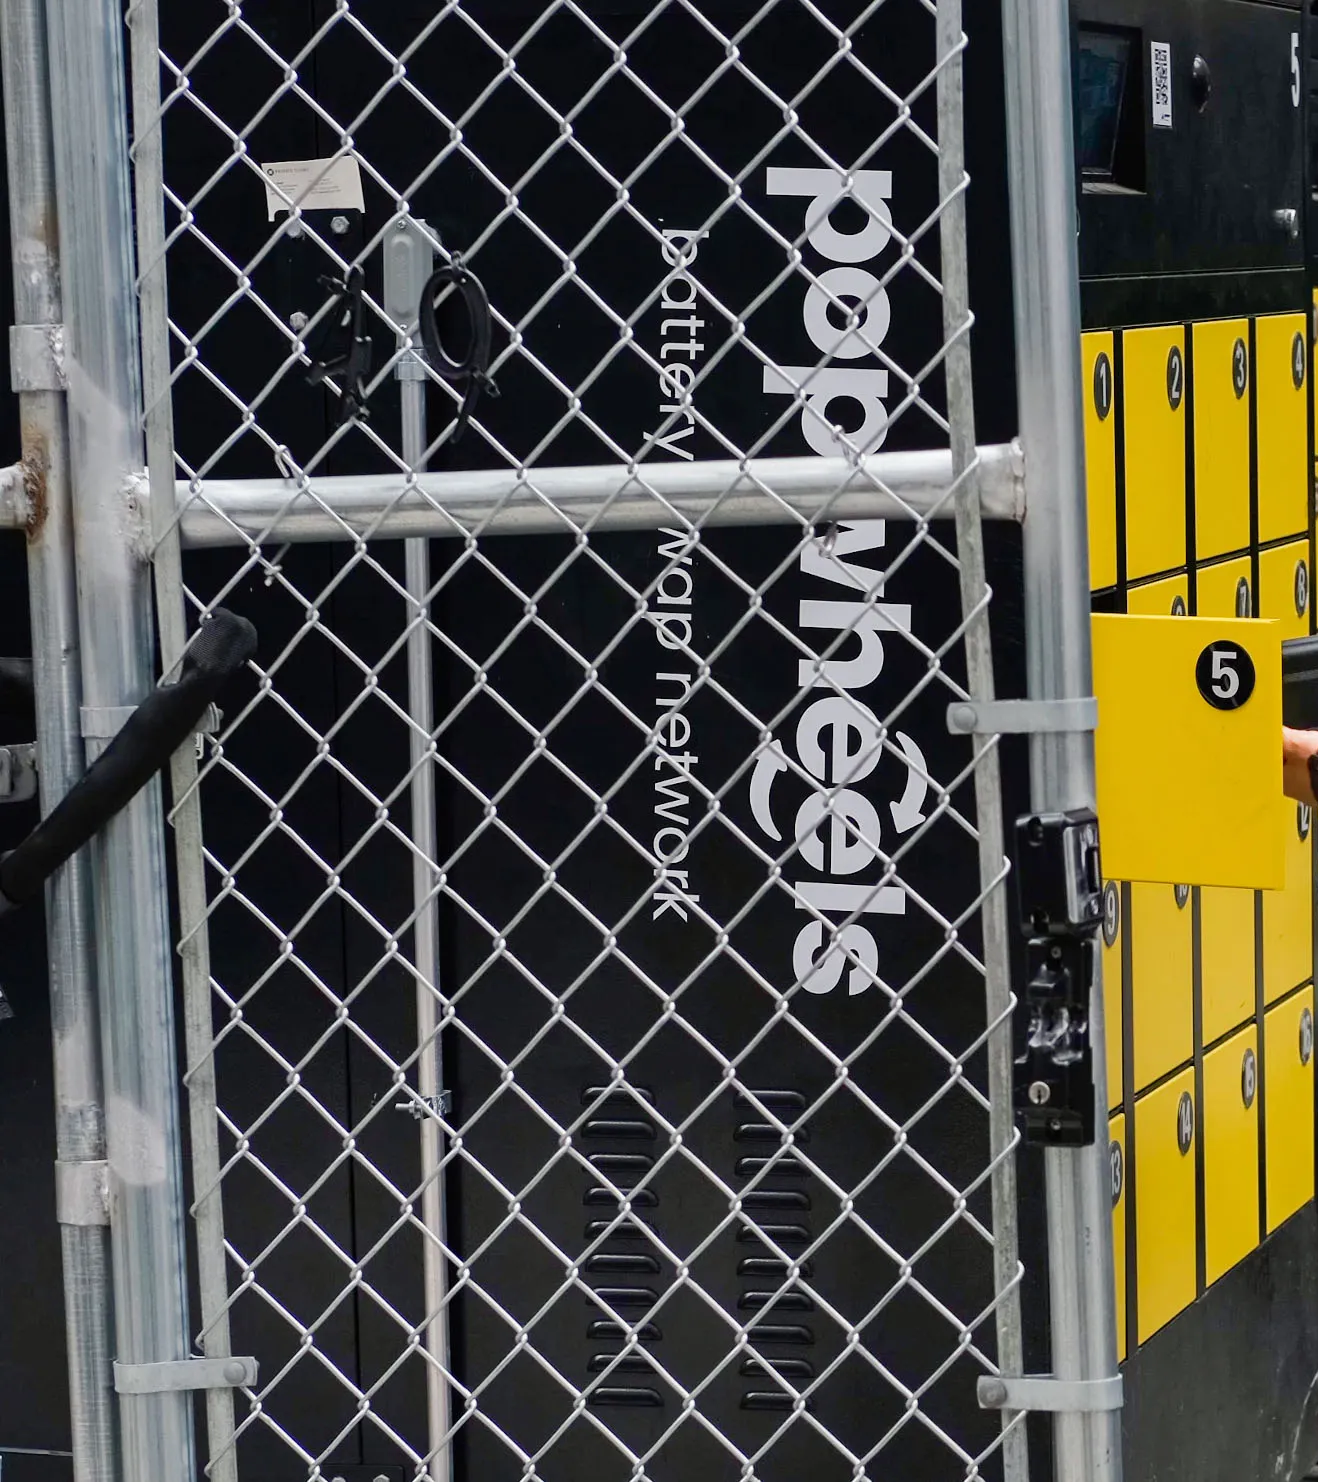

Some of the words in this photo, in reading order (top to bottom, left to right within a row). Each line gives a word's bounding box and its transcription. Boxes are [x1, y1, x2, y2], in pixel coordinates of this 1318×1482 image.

[1291, 32, 1300, 107] 5
[643, 229, 709, 461] battery
[1235, 344, 1245, 388] 3
[1295, 340, 1303, 379] 4
[1100, 363, 1107, 407] 1
[1171, 355, 1180, 399] 2
[641, 527, 694, 650] wap
[762, 167, 911, 996] popwheels
[1240, 585, 1247, 617] 7
[1299, 567, 1306, 608] 8
[1212, 651, 1239, 698] 5
[652, 672, 700, 923] network
[1107, 890, 1116, 935] 9
[1245, 1056, 1254, 1099] 15
[1180, 1100, 1191, 1144] 14
[1110, 1150, 1120, 1195] 13
